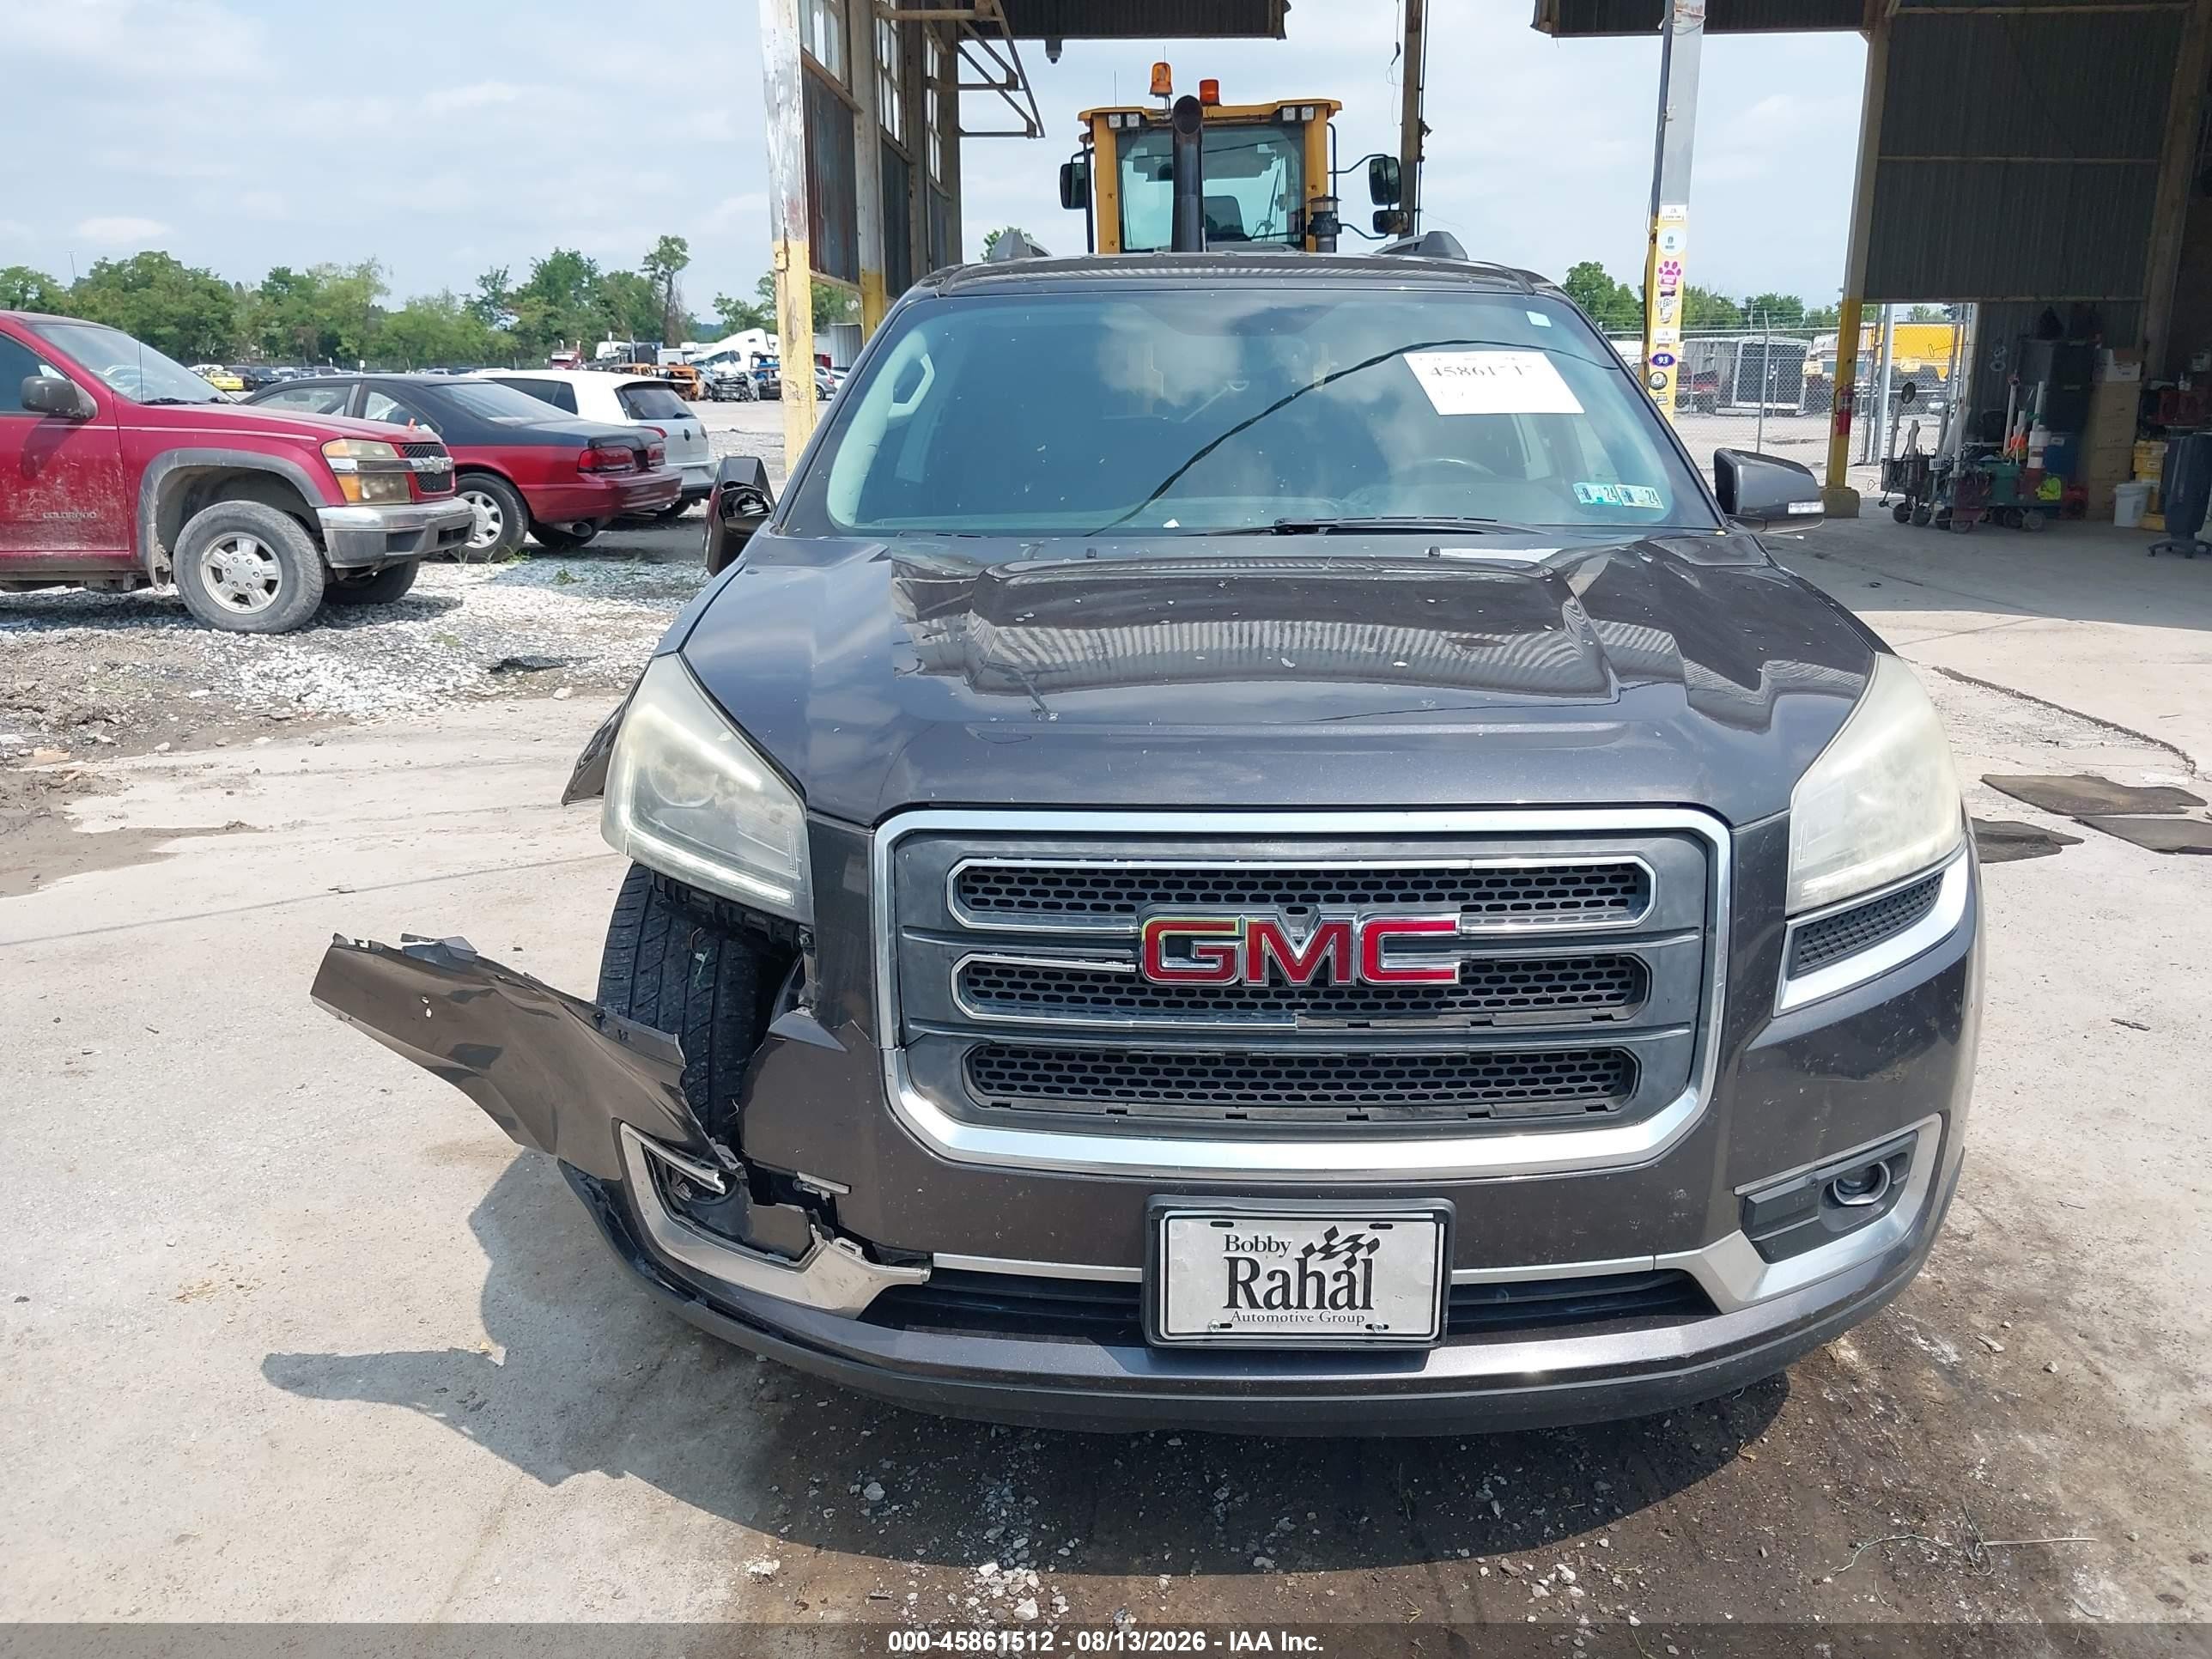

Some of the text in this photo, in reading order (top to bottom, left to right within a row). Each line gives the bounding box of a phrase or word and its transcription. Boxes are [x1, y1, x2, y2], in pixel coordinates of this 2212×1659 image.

[1657, 356, 1668, 364] 93
[1141, 915, 1461, 987] GMC
[1224, 1234, 1291, 1257] Bobby
[1223, 1256, 1374, 1310] Rahal
[1231, 1311, 1365, 1326] Automotive Group
